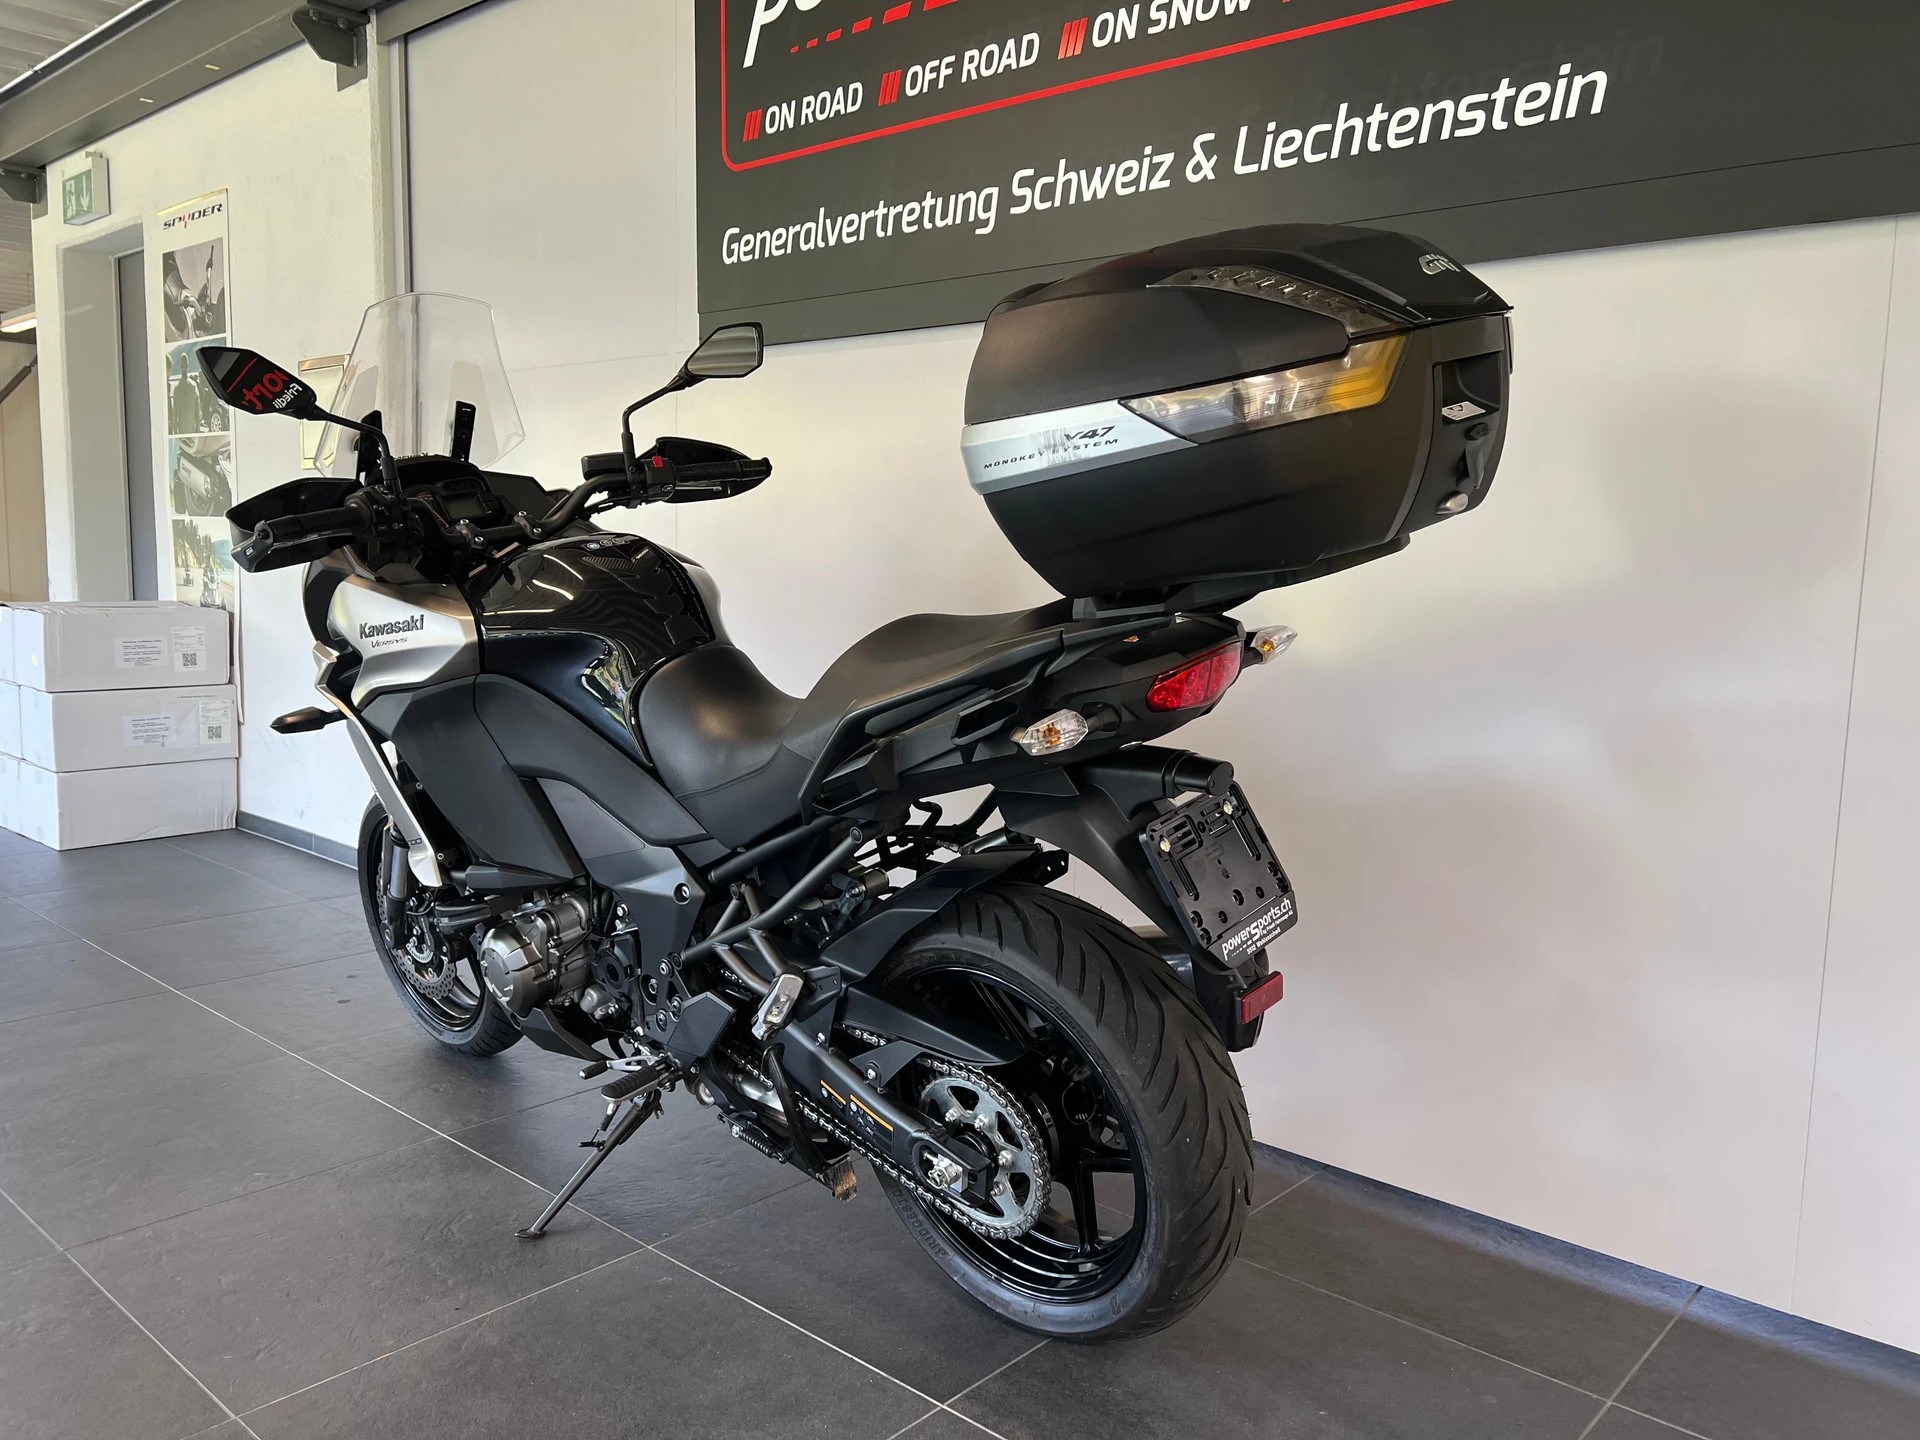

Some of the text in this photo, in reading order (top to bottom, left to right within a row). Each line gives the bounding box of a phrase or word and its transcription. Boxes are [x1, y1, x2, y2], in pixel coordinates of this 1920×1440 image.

[1092, 3, 1141, 48] ON
[905, 33, 1040, 97] OFF ROAD
[765, 81, 863, 135] ON ROAD
[722, 62, 1608, 265] Generalvertretung Schweiz & Liechtenstein
[162, 203, 223, 230] SPYDER
[983, 447, 1046, 469] MONOKEY
[1063, 425, 1116, 442] V47
[359, 614, 425, 639] Kawasaki
[1221, 897, 1292, 962] powerSports.ch
[888, 1182, 950, 1259] BRIDGESTO
